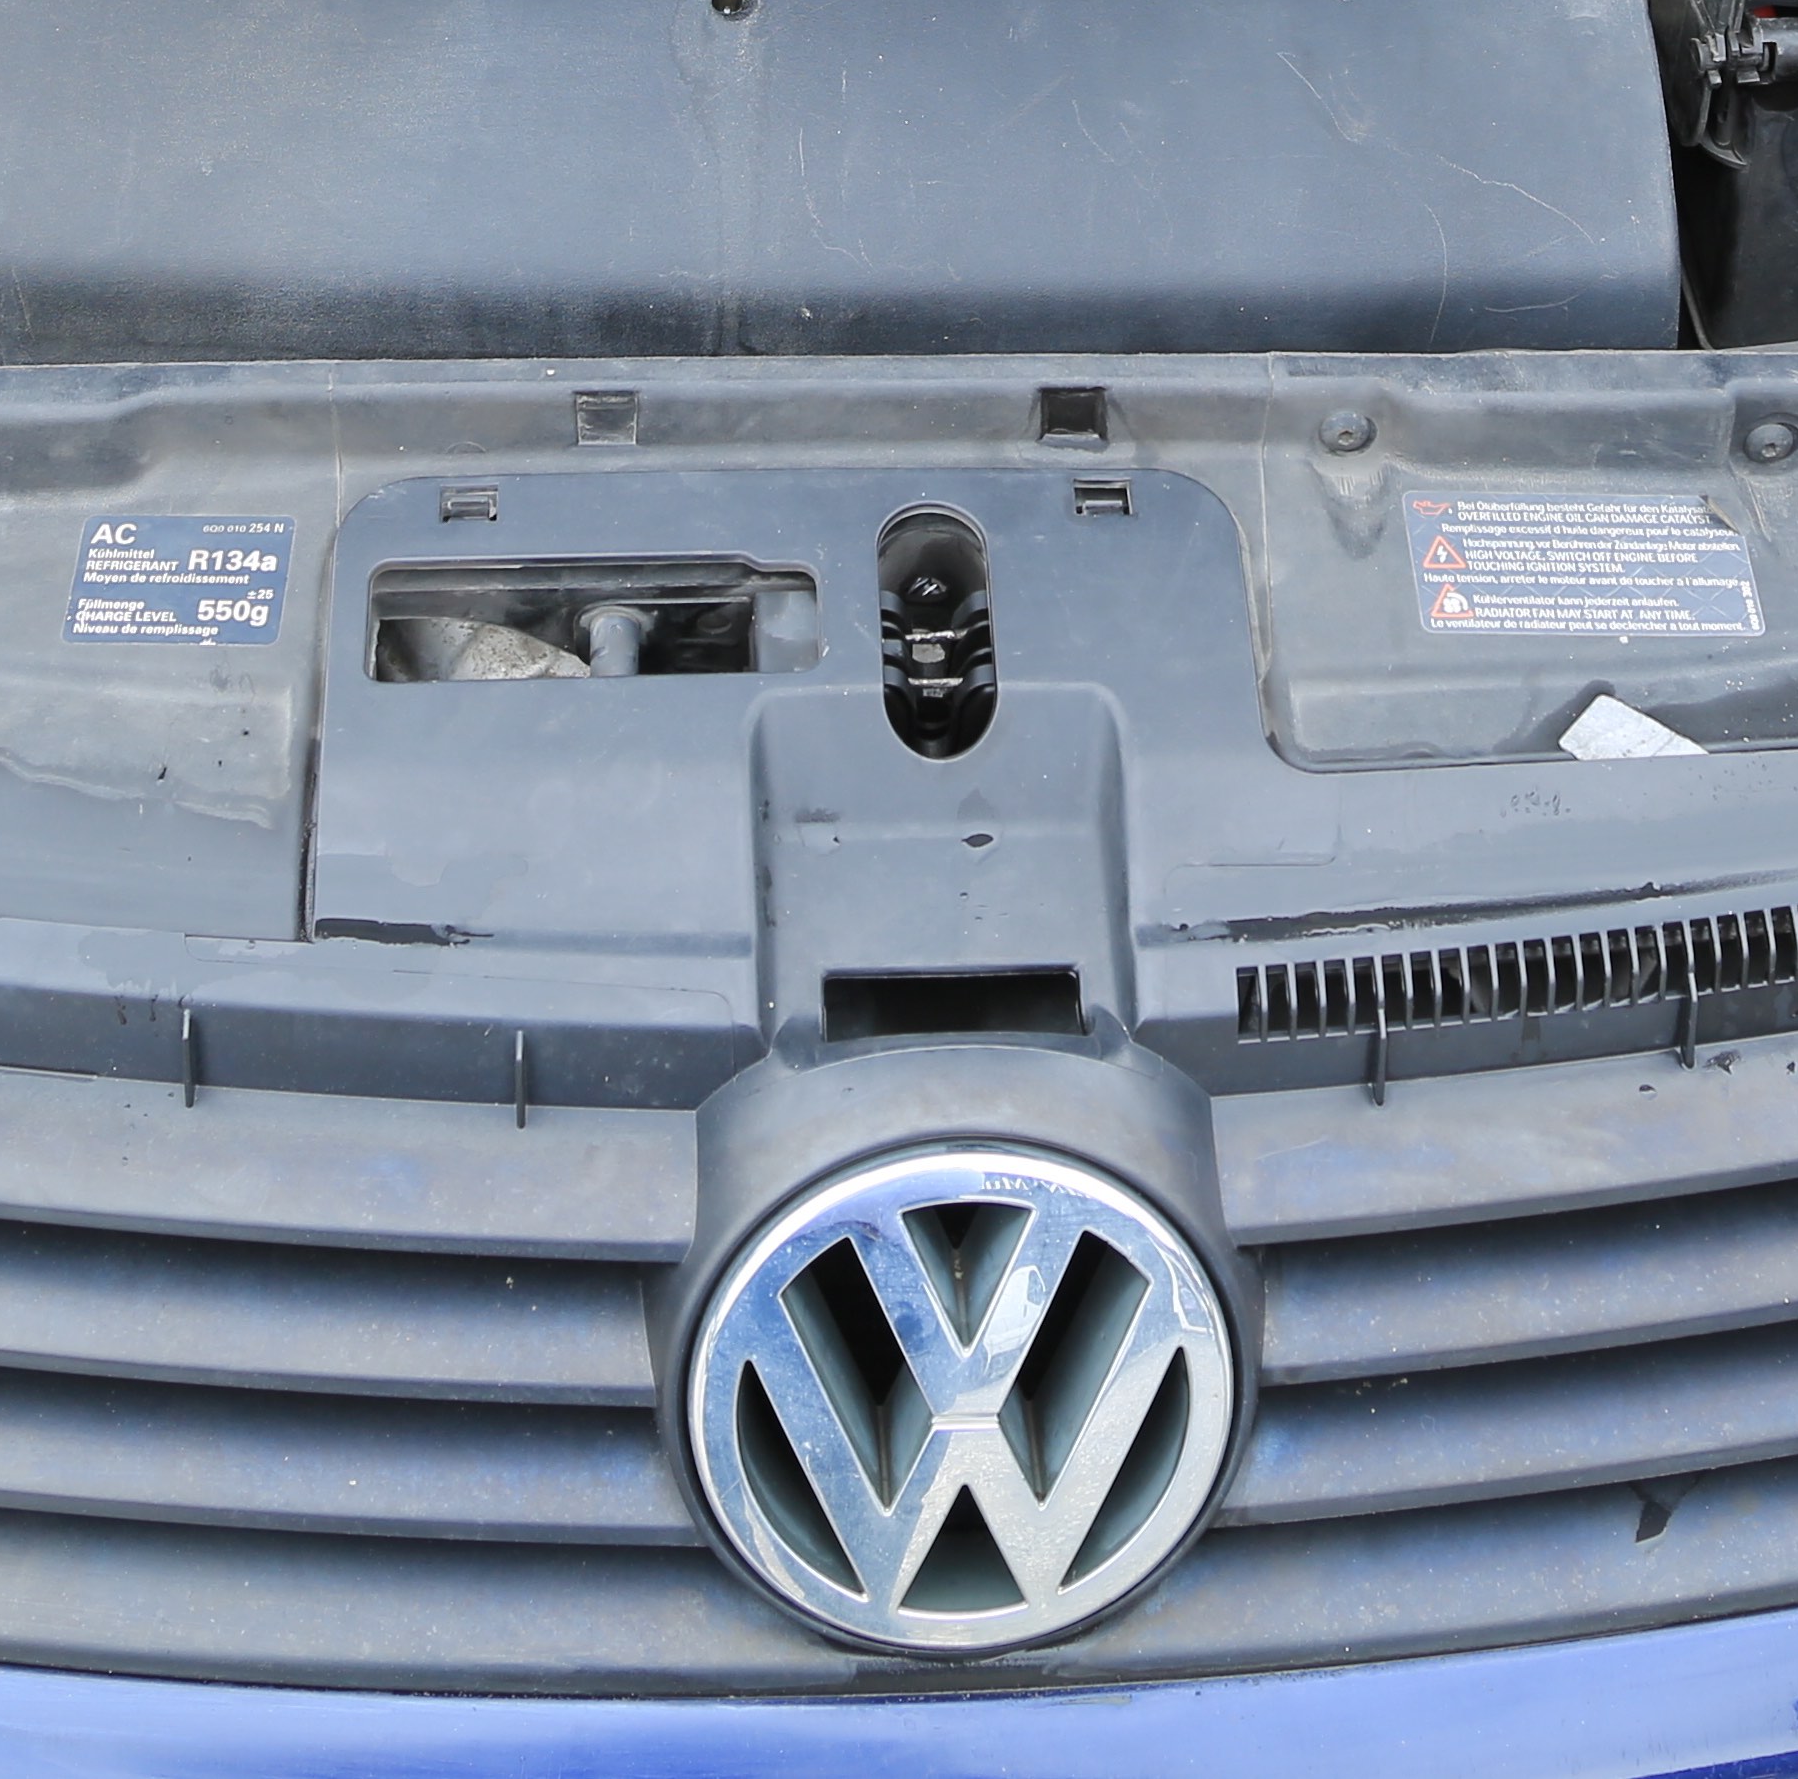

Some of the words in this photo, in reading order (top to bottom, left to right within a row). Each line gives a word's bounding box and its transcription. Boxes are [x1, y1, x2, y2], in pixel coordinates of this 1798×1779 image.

[1457, 500, 1475, 512] Bei
[1546, 501, 1586, 513] besteht
[1586, 503, 1621, 514] Gefahr
[1640, 503, 1660, 514] den
[1457, 512, 1521, 522] OVERFILLED
[1523, 512, 1565, 523] ENGINE
[1565, 513, 1584, 523] OIL
[1584, 514, 1610, 523] CAN
[1610, 514, 1658, 524] DAMAGE
[90, 523, 137, 546] AC
[248, 522, 271, 534] 254
[274, 522, 284, 534] N
[1441, 523, 1507, 536] Remplissage
[1508, 524, 1552, 535] excessif
[1589, 525, 1645, 536] dangereux
[1646, 526, 1669, 538] pour
[1670, 526, 1682, 537] le
[87, 548, 155, 560] Kühlmittel
[187, 550, 278, 572] R134a
[1464, 549, 1493, 561] HIGH
[1547, 550, 1590, 562] SWITCH
[1592, 552, 1612, 563] OFF
[1613, 552, 1656, 563] ENGINE
[1657, 552, 1698, 563] BEFORE
[85, 560, 179, 572] REFRIGERANT
[1466, 561, 1525, 572] TOUCHING
[1526, 561, 1577, 572] IGNITION
[83, 572, 127, 585] Moyen
[130, 573, 147, 584] de
[149, 572, 250, 585] refroidissement
[1423, 573, 1455, 583] Haute
[1537, 574, 1548, 584] le
[1549, 574, 1587, 585] moteur
[1588, 576, 1618, 586] avant
[1619, 577, 1633, 586] de
[1634, 577, 1674, 586] toucher
[1556, 595, 1584, 606] kann
[1584, 596, 1630, 608] jederzeit
[75, 610, 132, 624] CHARGE
[134, 610, 177, 622] LEVEL
[78, 598, 146, 611] Füllmenge
[197, 600, 270, 627] 550g
[1474, 607, 1530, 618] RADIATOR
[1532, 607, 1555, 618] FAN
[1557, 608, 1582, 619] MAY
[1584, 609, 1618, 620] START
[1620, 610, 1634, 620] AT
[1639, 610, 1662, 620] ANY
[72, 623, 119, 635] Niveau
[121, 624, 138, 635] de
[140, 624, 219, 637] remplissage
[1430, 618, 1445, 628] Le
[1444, 618, 1501, 629] ventilateur
[1503, 619, 1517, 629] de
[1519, 619, 1567, 630] radiateur
[1568, 620, 1593, 631] peut
[1594, 622, 1607, 630] se
[1678, 621, 1701, 631] tout
[688, 1137, 1234, 1655] VW
